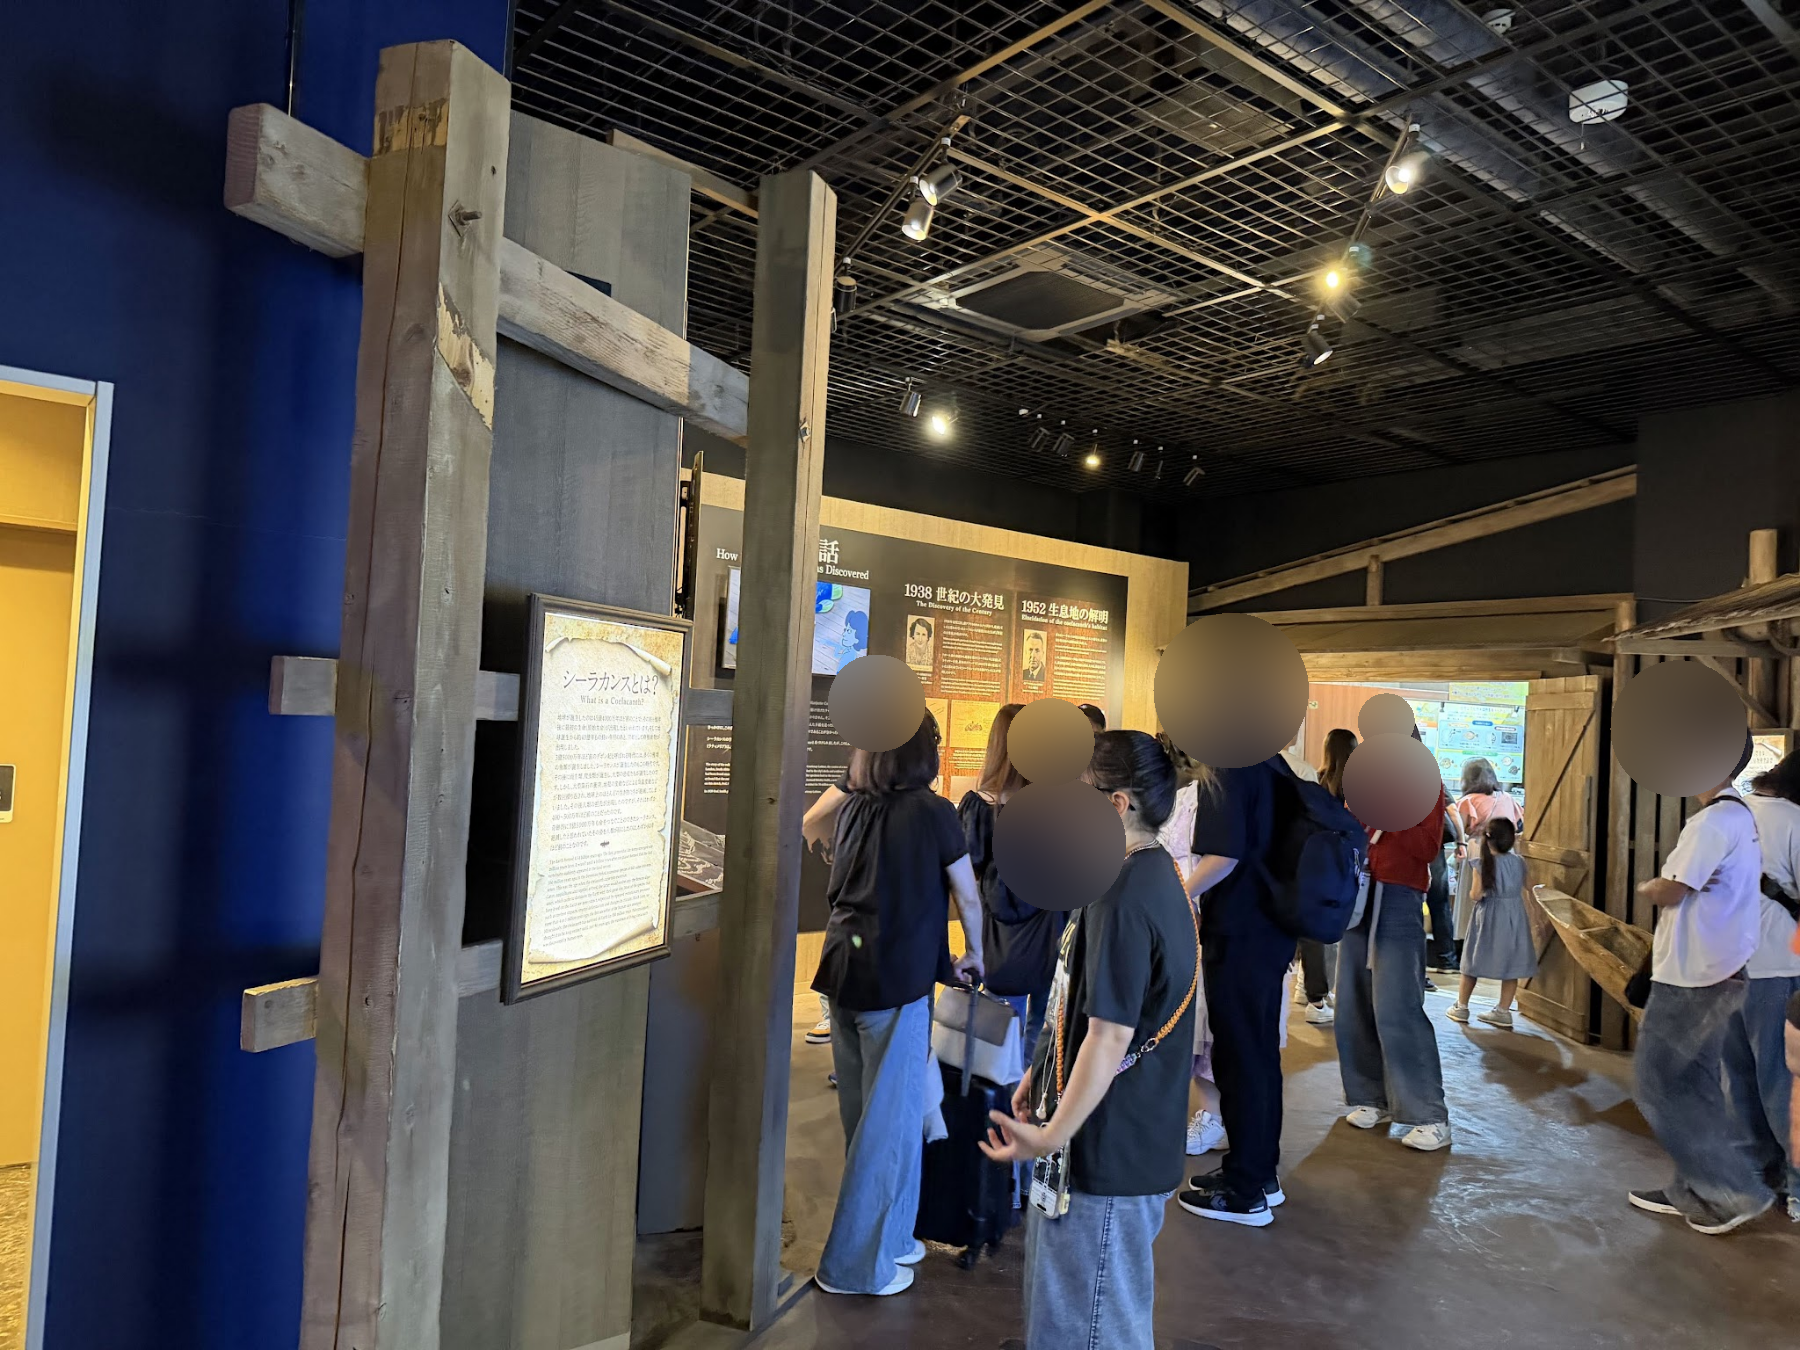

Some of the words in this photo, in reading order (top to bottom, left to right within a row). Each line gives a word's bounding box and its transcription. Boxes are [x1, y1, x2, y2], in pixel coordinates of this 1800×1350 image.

[716, 547, 739, 562] How
[818, 538, 840, 565] 話
[825, 564, 869, 580] Discovered
[904, 583, 932, 600] 1938
[935, 586, 1005, 611] 世紀の大発見
[916, 600, 927, 608] The
[928, 601, 954, 613] Discovery
[962, 606, 971, 614] the
[971, 607, 993, 617] Century
[1021, 599, 1046, 615] 1952
[1048, 602, 1109, 624] 生息地の解明
[580, 694, 597, 705] What
[597, 695, 604, 705] is
[604, 697, 609, 705] a
